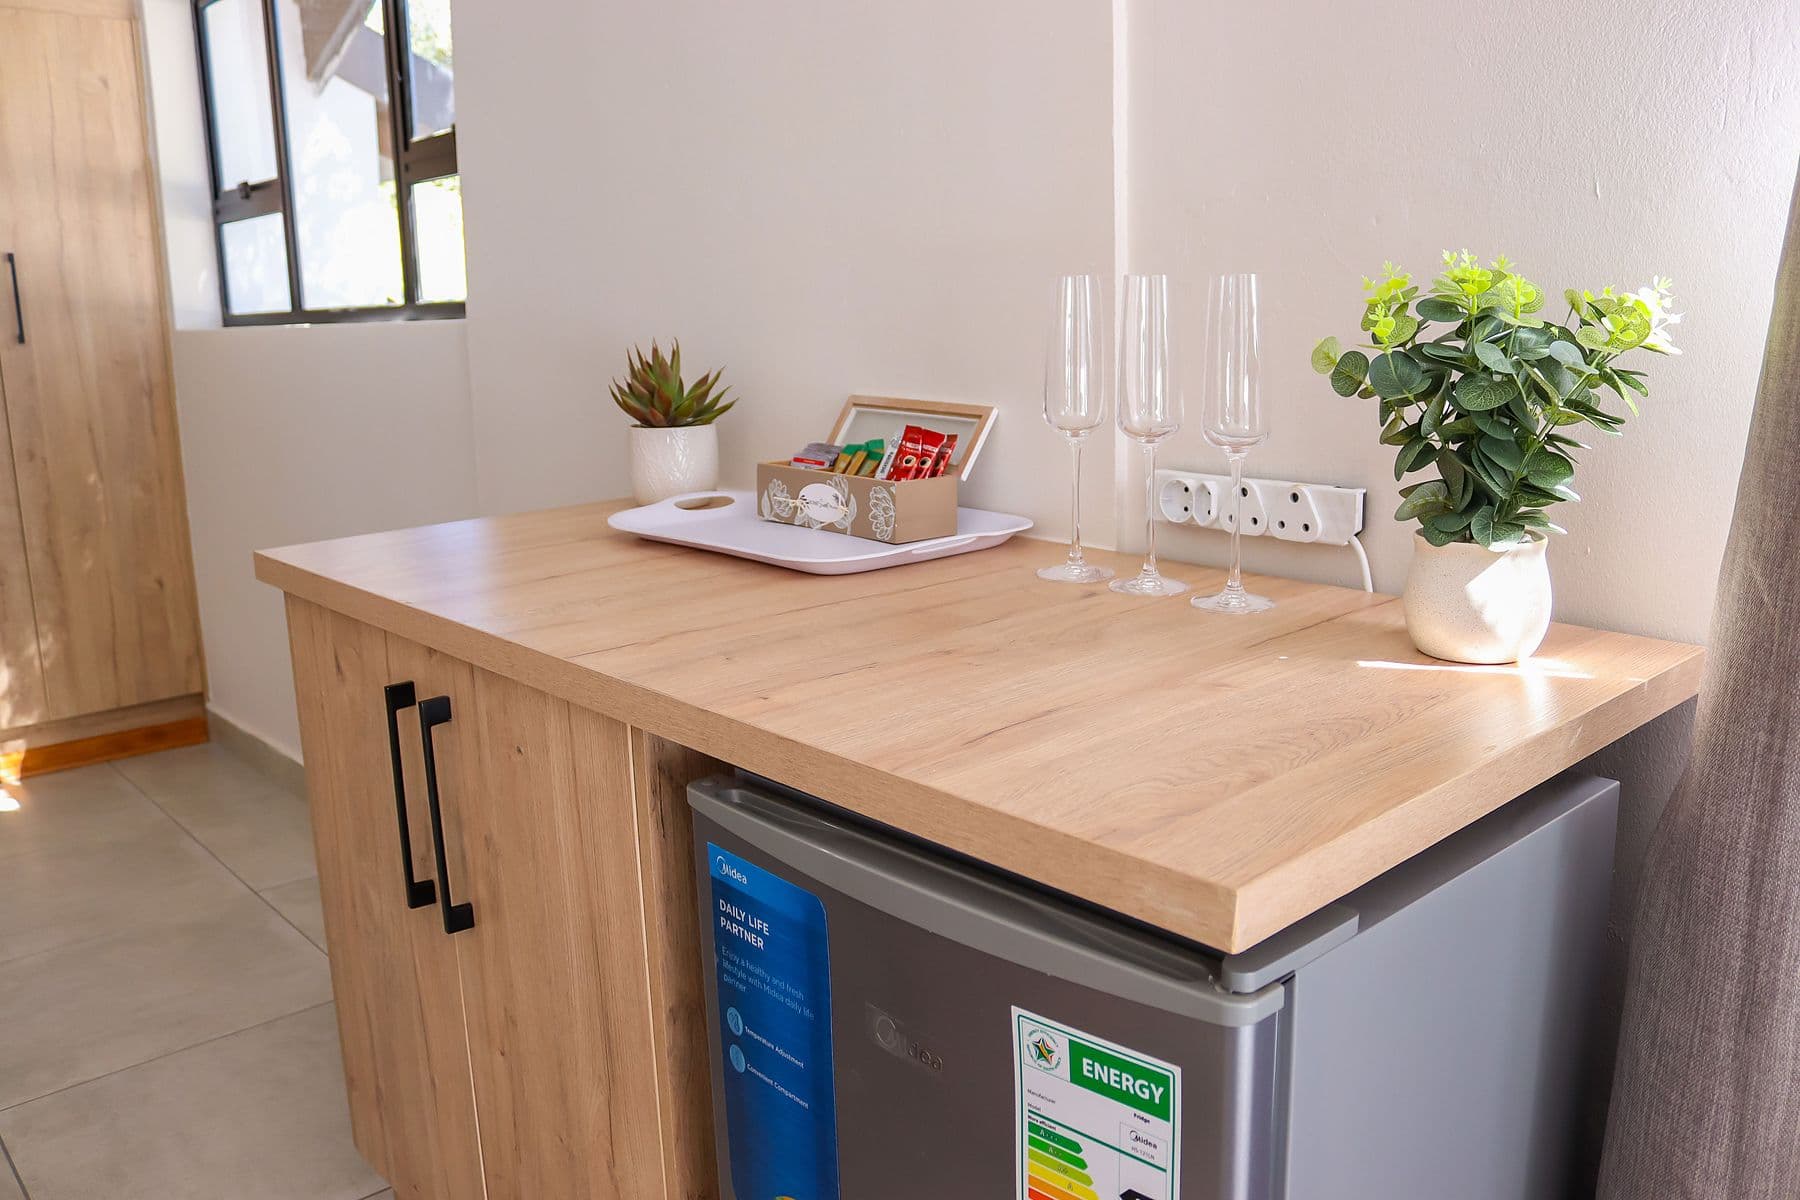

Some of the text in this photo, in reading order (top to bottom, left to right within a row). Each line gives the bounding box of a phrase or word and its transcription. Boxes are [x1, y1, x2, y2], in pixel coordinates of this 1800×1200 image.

[716, 855, 748, 885] Midea
[719, 899, 770, 936] DAILY LIFE
[720, 917, 764, 950] PARTNER
[748, 976, 763, 989] with
[771, 976, 785, 990] and
[1082, 1057, 1164, 1104] ENERGY
[1133, 1112, 1151, 1124] Fridge
[1129, 1129, 1158, 1150] Midea
